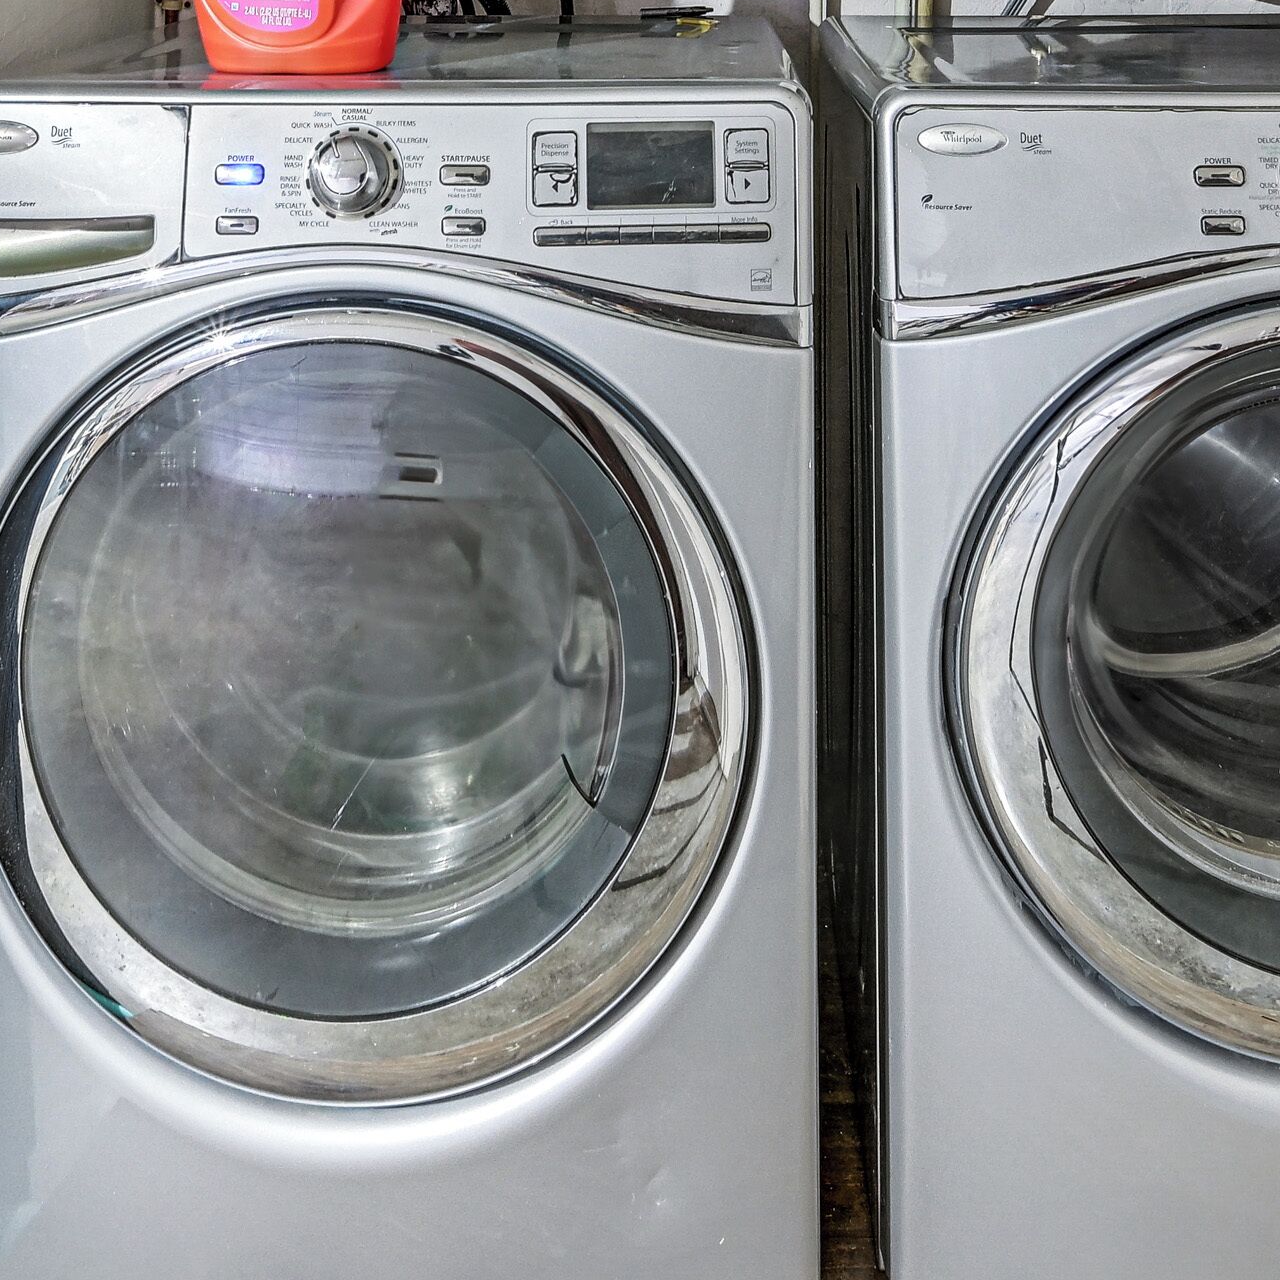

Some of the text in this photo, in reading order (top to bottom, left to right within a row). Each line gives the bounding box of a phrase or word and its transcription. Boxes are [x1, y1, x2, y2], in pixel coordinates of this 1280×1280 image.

[51, 126, 72, 137] Duet
[943, 135, 982, 144] Whirlpool
[1021, 132, 1042, 143] Duet
[736, 140, 758, 148] System
[735, 147, 760, 155] Settings
